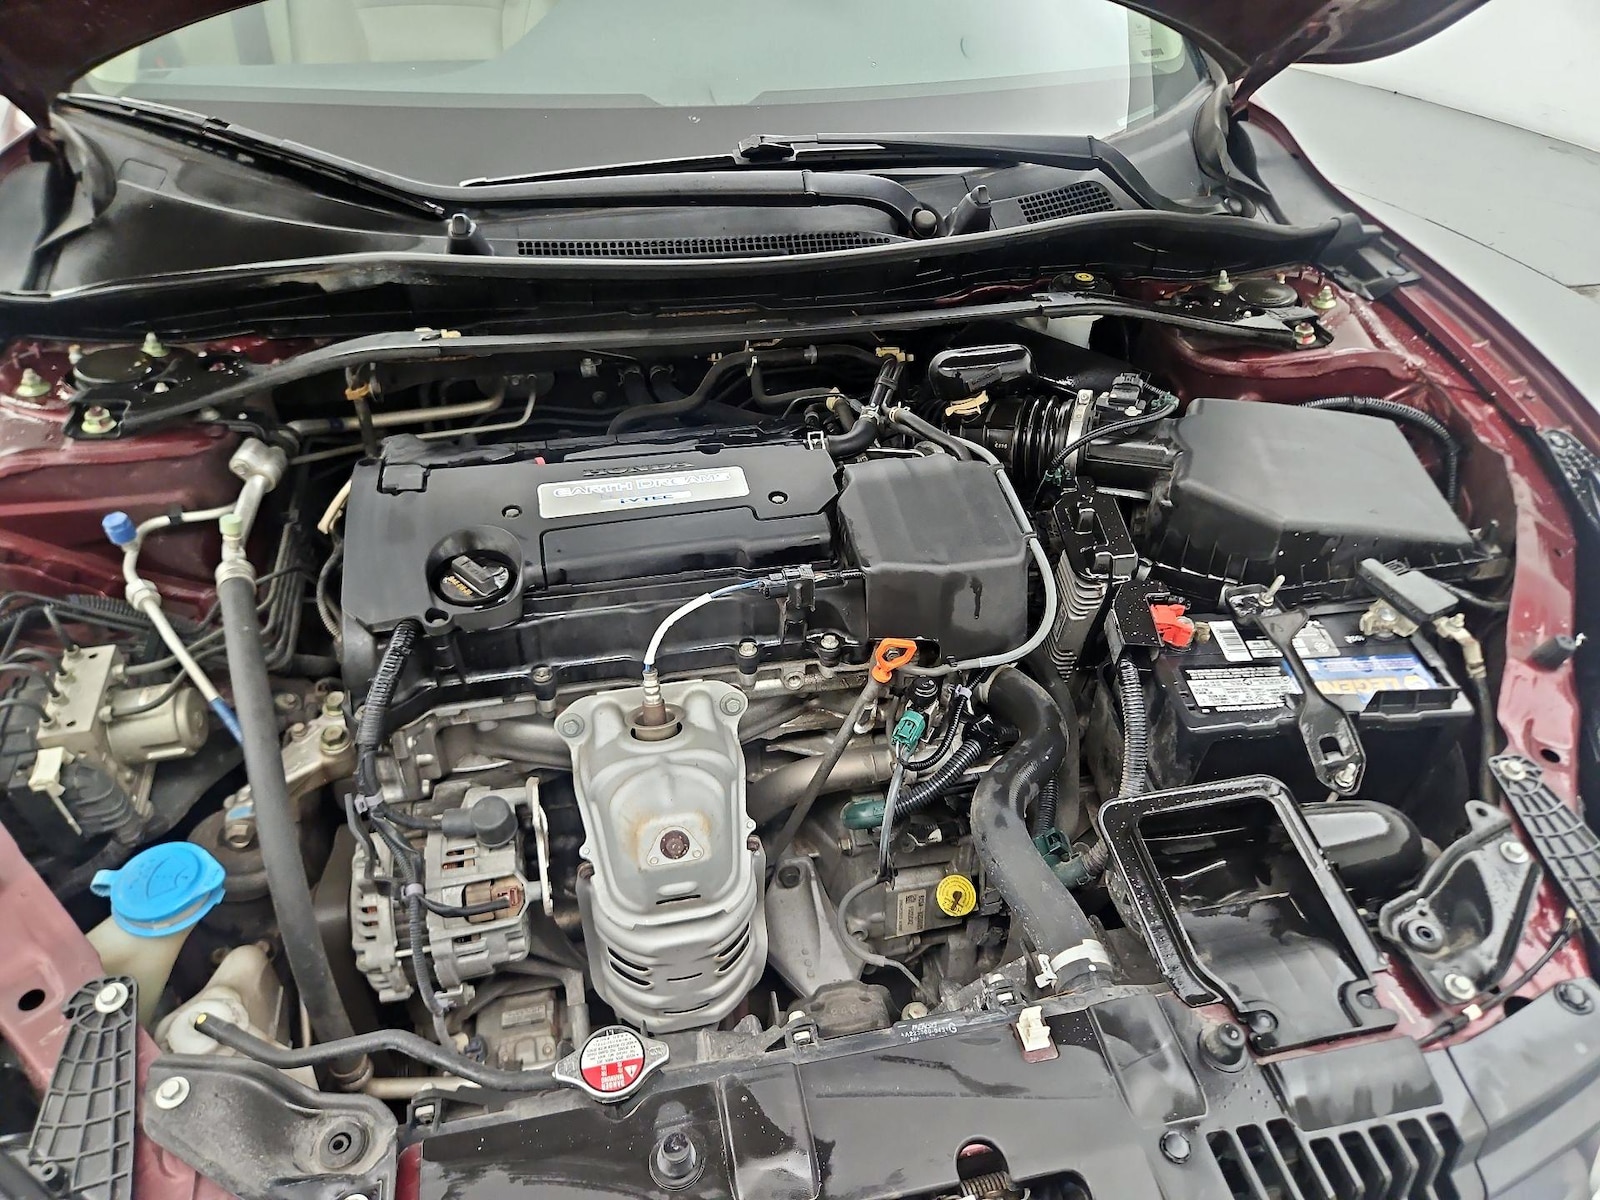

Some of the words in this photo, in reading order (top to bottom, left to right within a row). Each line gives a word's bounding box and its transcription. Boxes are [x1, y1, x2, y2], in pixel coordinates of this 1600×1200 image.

[583, 461, 695, 477] HONDA
[553, 481, 633, 498] EARTH
[636, 472, 731, 490] DREAMS
